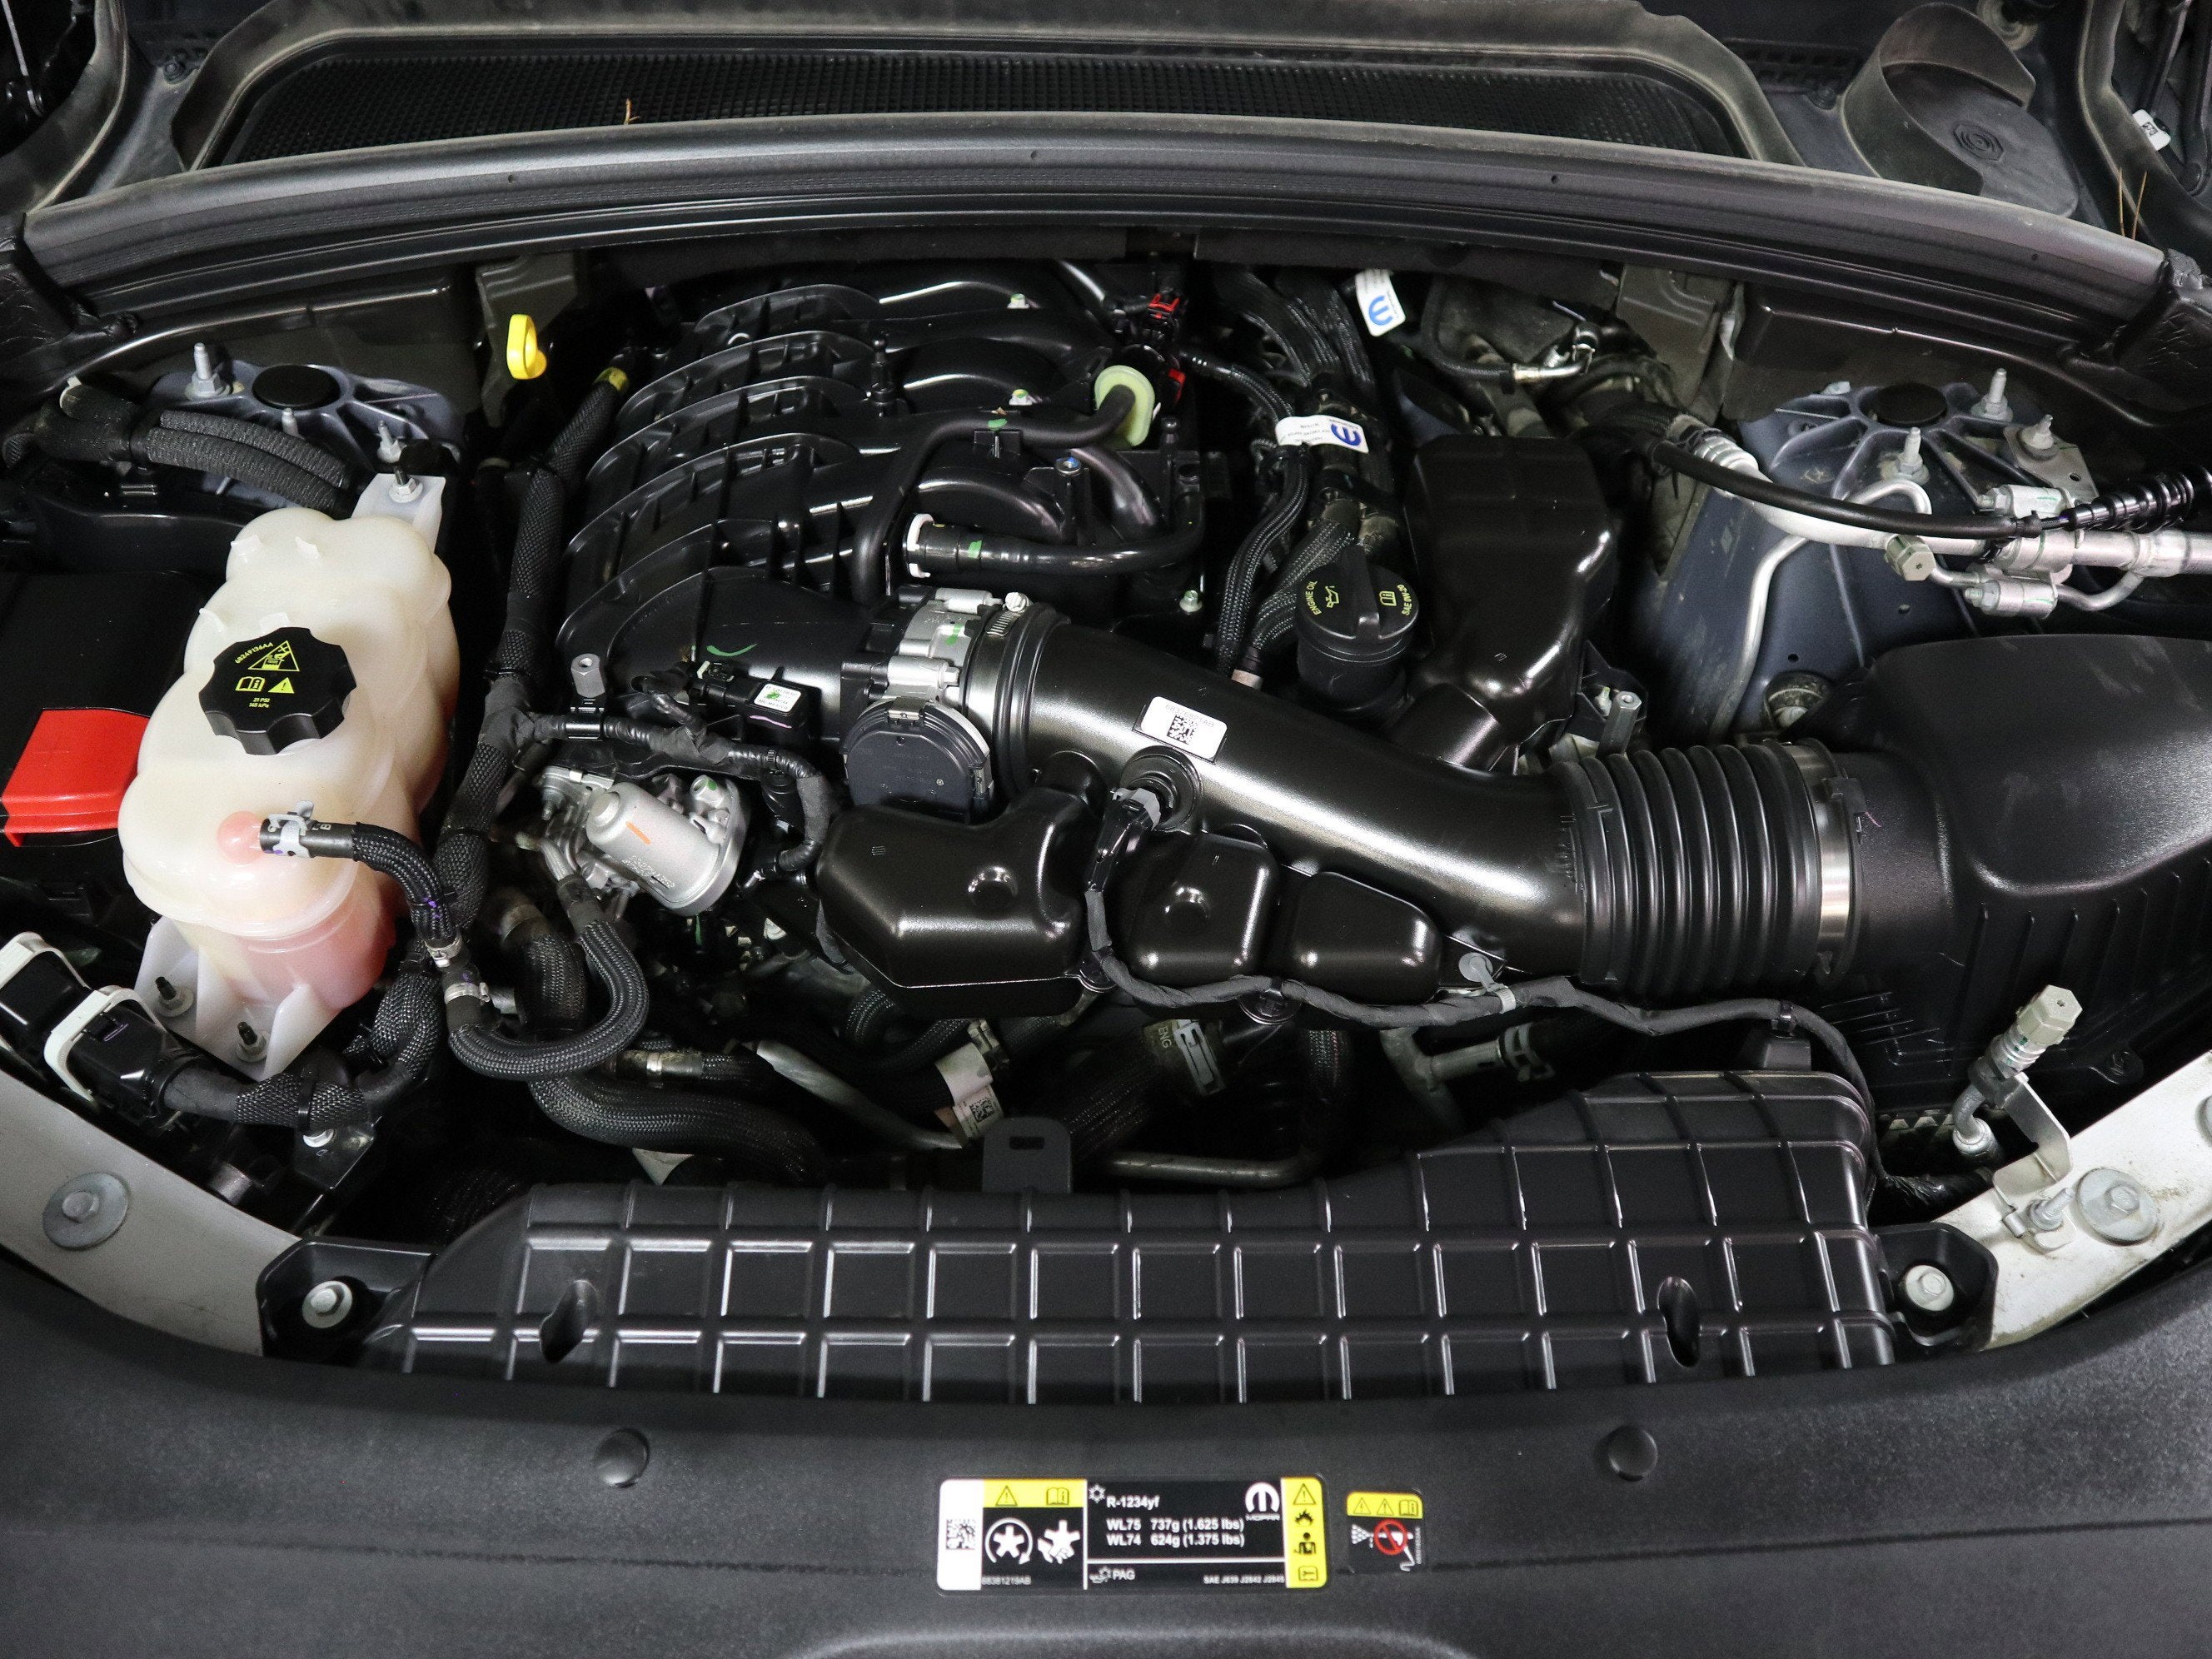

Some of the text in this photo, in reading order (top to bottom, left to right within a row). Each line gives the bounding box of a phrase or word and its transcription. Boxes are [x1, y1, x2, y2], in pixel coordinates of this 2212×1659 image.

[1306, 590, 1322, 615] ENGINE
[1397, 584, 1412, 615] SAE 0W-20
[1158, 1027, 1172, 1048] ENG
[1105, 1495, 1160, 1511] R-1234yf
[1106, 1517, 1244, 1533] WL75 737g (1.625 lbs)
[1106, 1532, 1245, 1548] WL74 624g (1.375 lbs)
[1113, 1568, 1136, 1581] PAG
[1203, 1575, 1220, 1584] SAE
